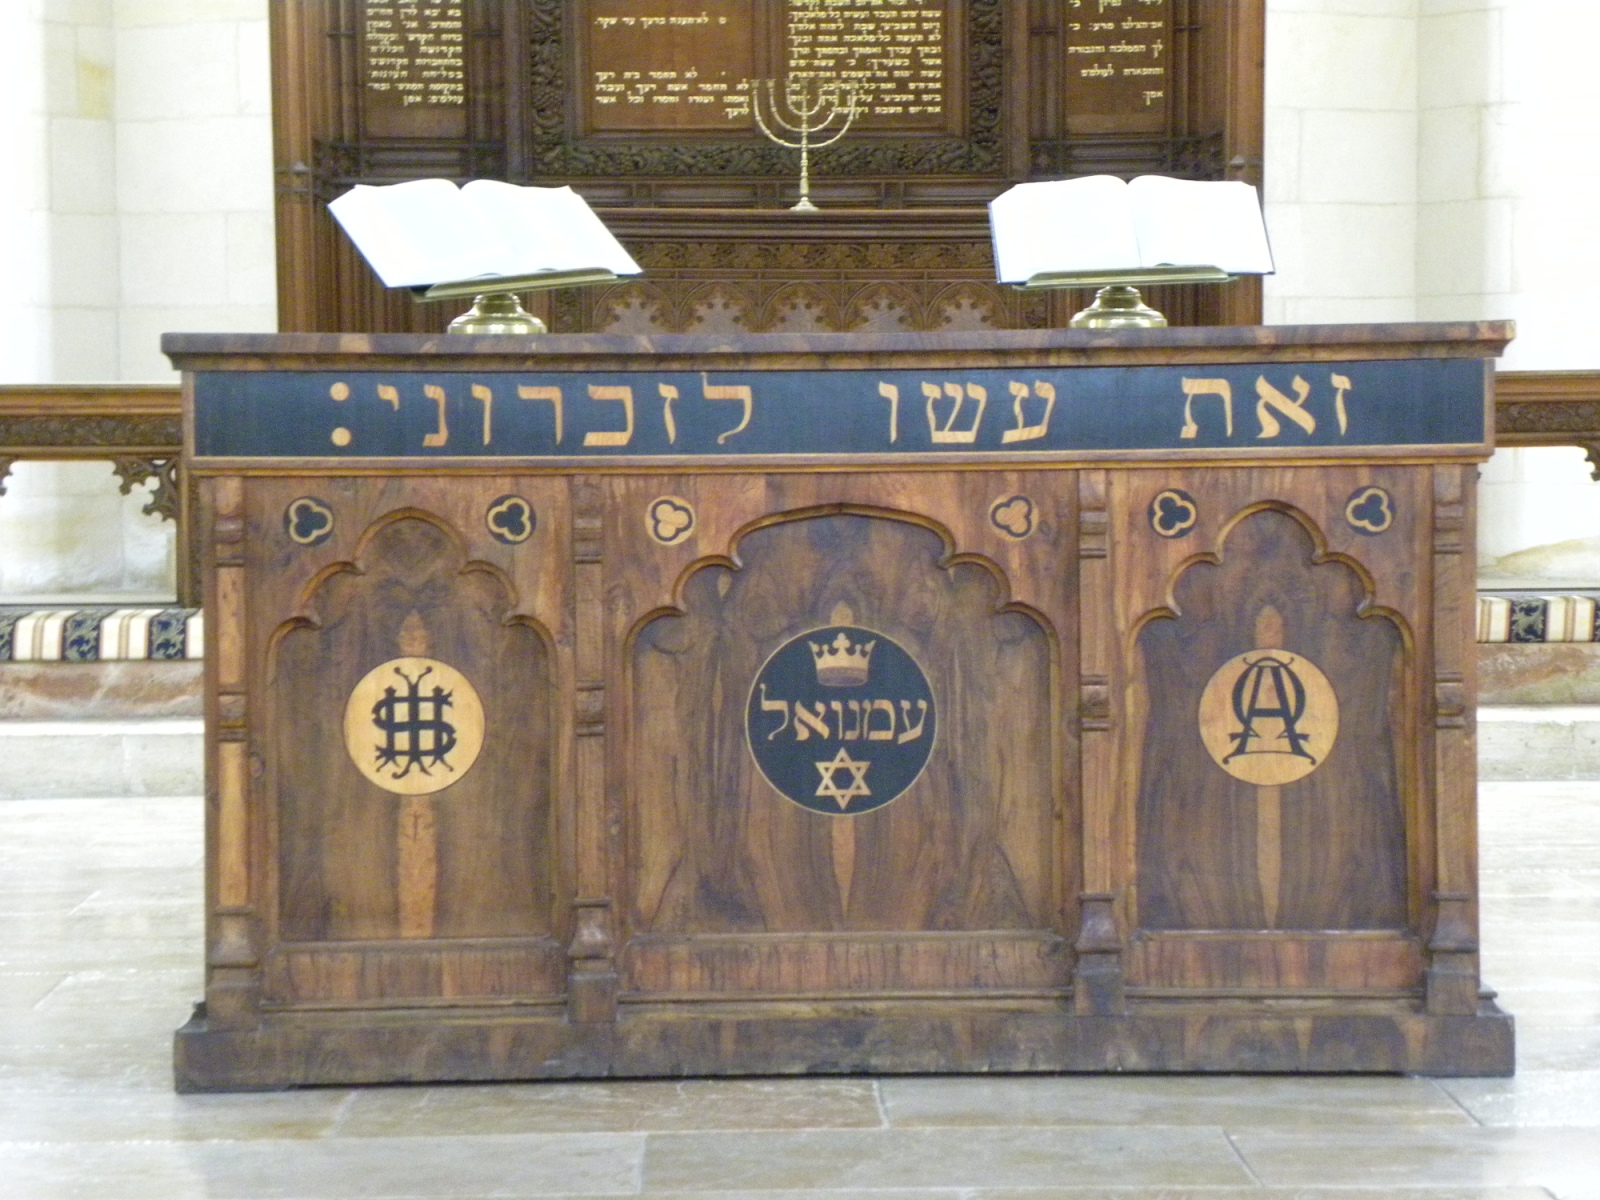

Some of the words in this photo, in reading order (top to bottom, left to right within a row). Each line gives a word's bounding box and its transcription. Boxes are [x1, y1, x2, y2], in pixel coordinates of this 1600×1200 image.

[878, 379, 1056, 445] עשו
[1179, 372, 1353, 439] זאת
[759, 683, 928, 745] עמנואל
